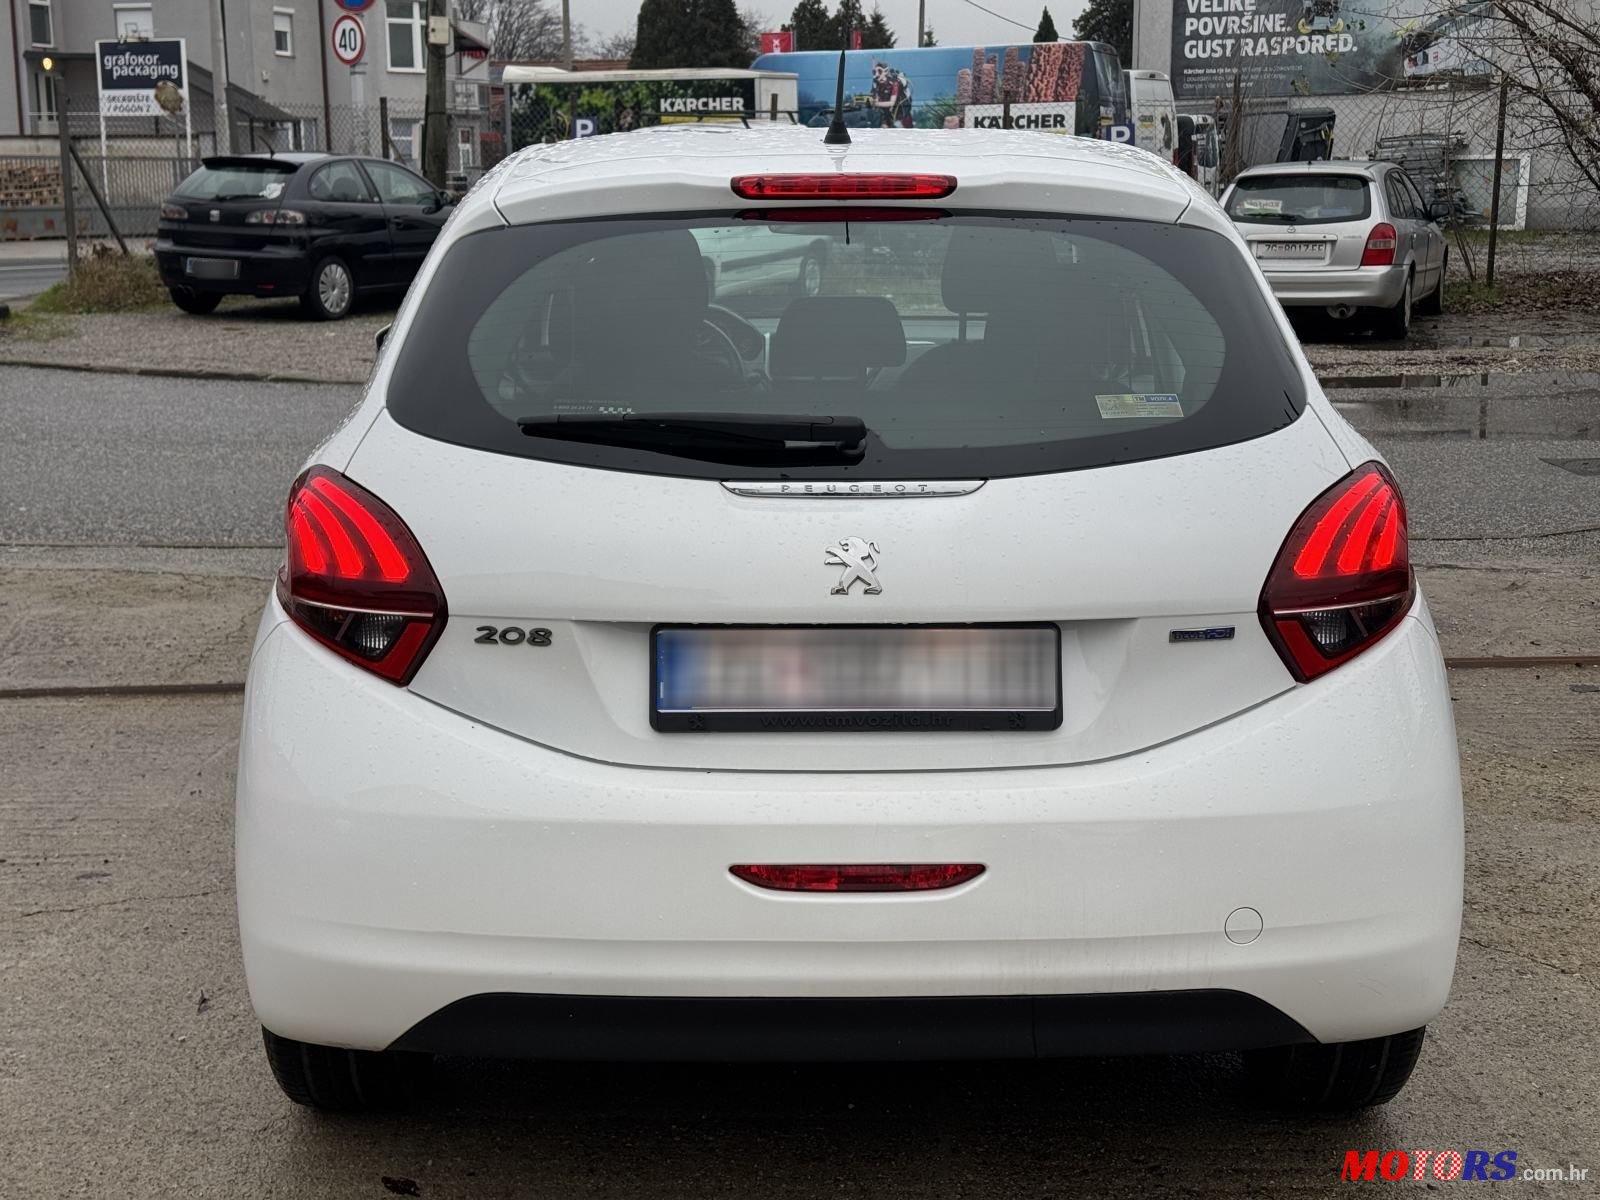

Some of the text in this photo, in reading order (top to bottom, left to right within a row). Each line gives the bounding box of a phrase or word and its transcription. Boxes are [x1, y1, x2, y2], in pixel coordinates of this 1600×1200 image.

[1186, 0, 1257, 13] VELIKE
[1185, 12, 1292, 36] POVRŠINE.
[339, 27, 357, 52] 40
[1184, 33, 1358, 59] GUST RASPORED.
[112, 64, 179, 80] packaging
[660, 97, 744, 112] KÄRCHER
[575, 119, 594, 138] P
[974, 113, 1066, 130] KÄRCHER
[1111, 126, 1130, 142] P
[780, 484, 928, 494] PEUGEOT
[474, 625, 553, 647] 208
